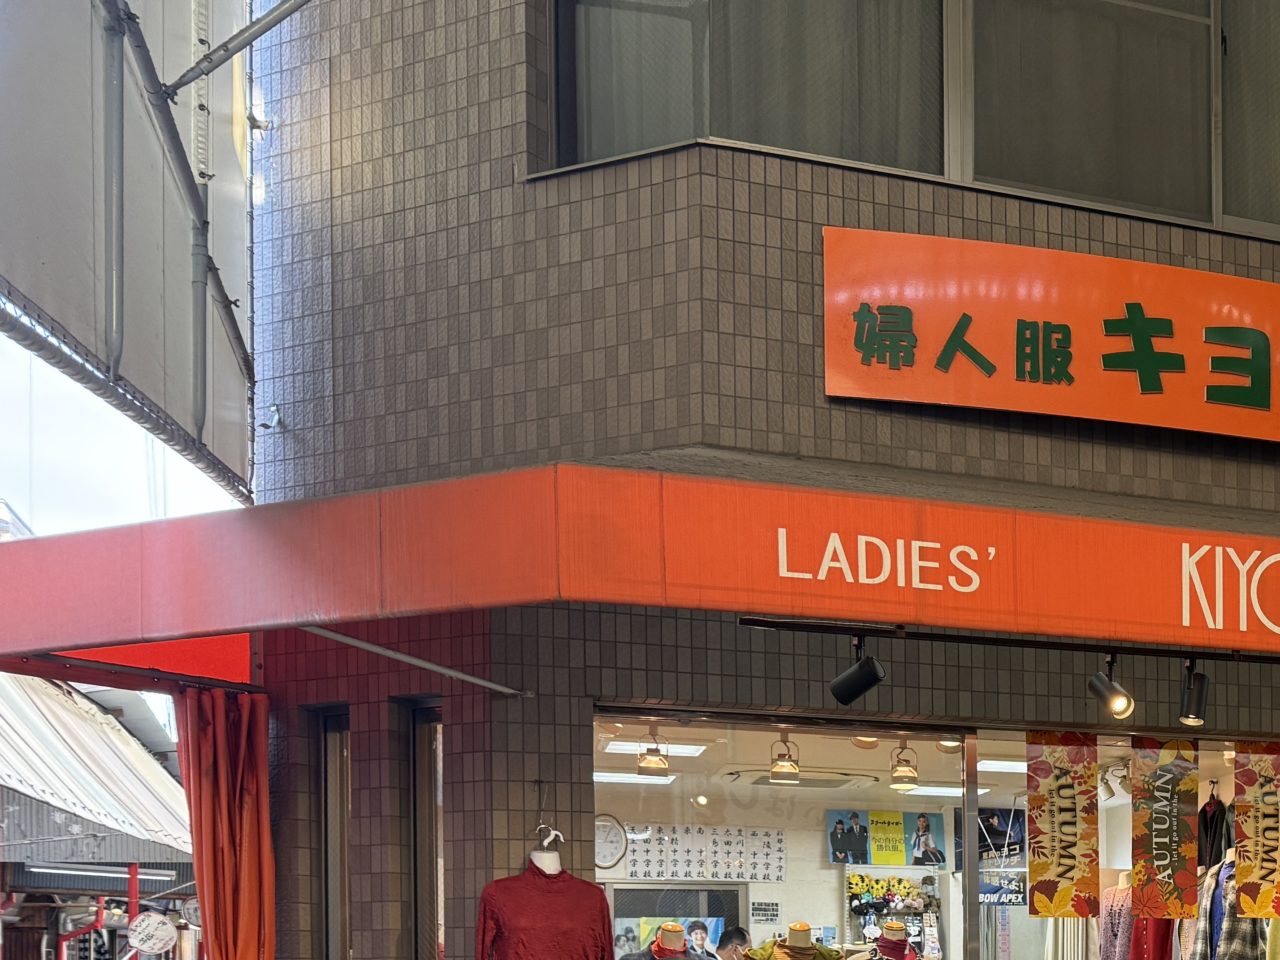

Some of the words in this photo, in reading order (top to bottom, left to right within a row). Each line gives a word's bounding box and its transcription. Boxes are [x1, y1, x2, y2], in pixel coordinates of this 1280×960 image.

[852, 303, 1074, 386] 婦人服
[1054, 765, 1077, 882] AUTUMN
[1152, 770, 1174, 884] AUTUMN
[1260, 773, 1279, 885] AUTUMN
[1000, 893, 1024, 903] APEX
